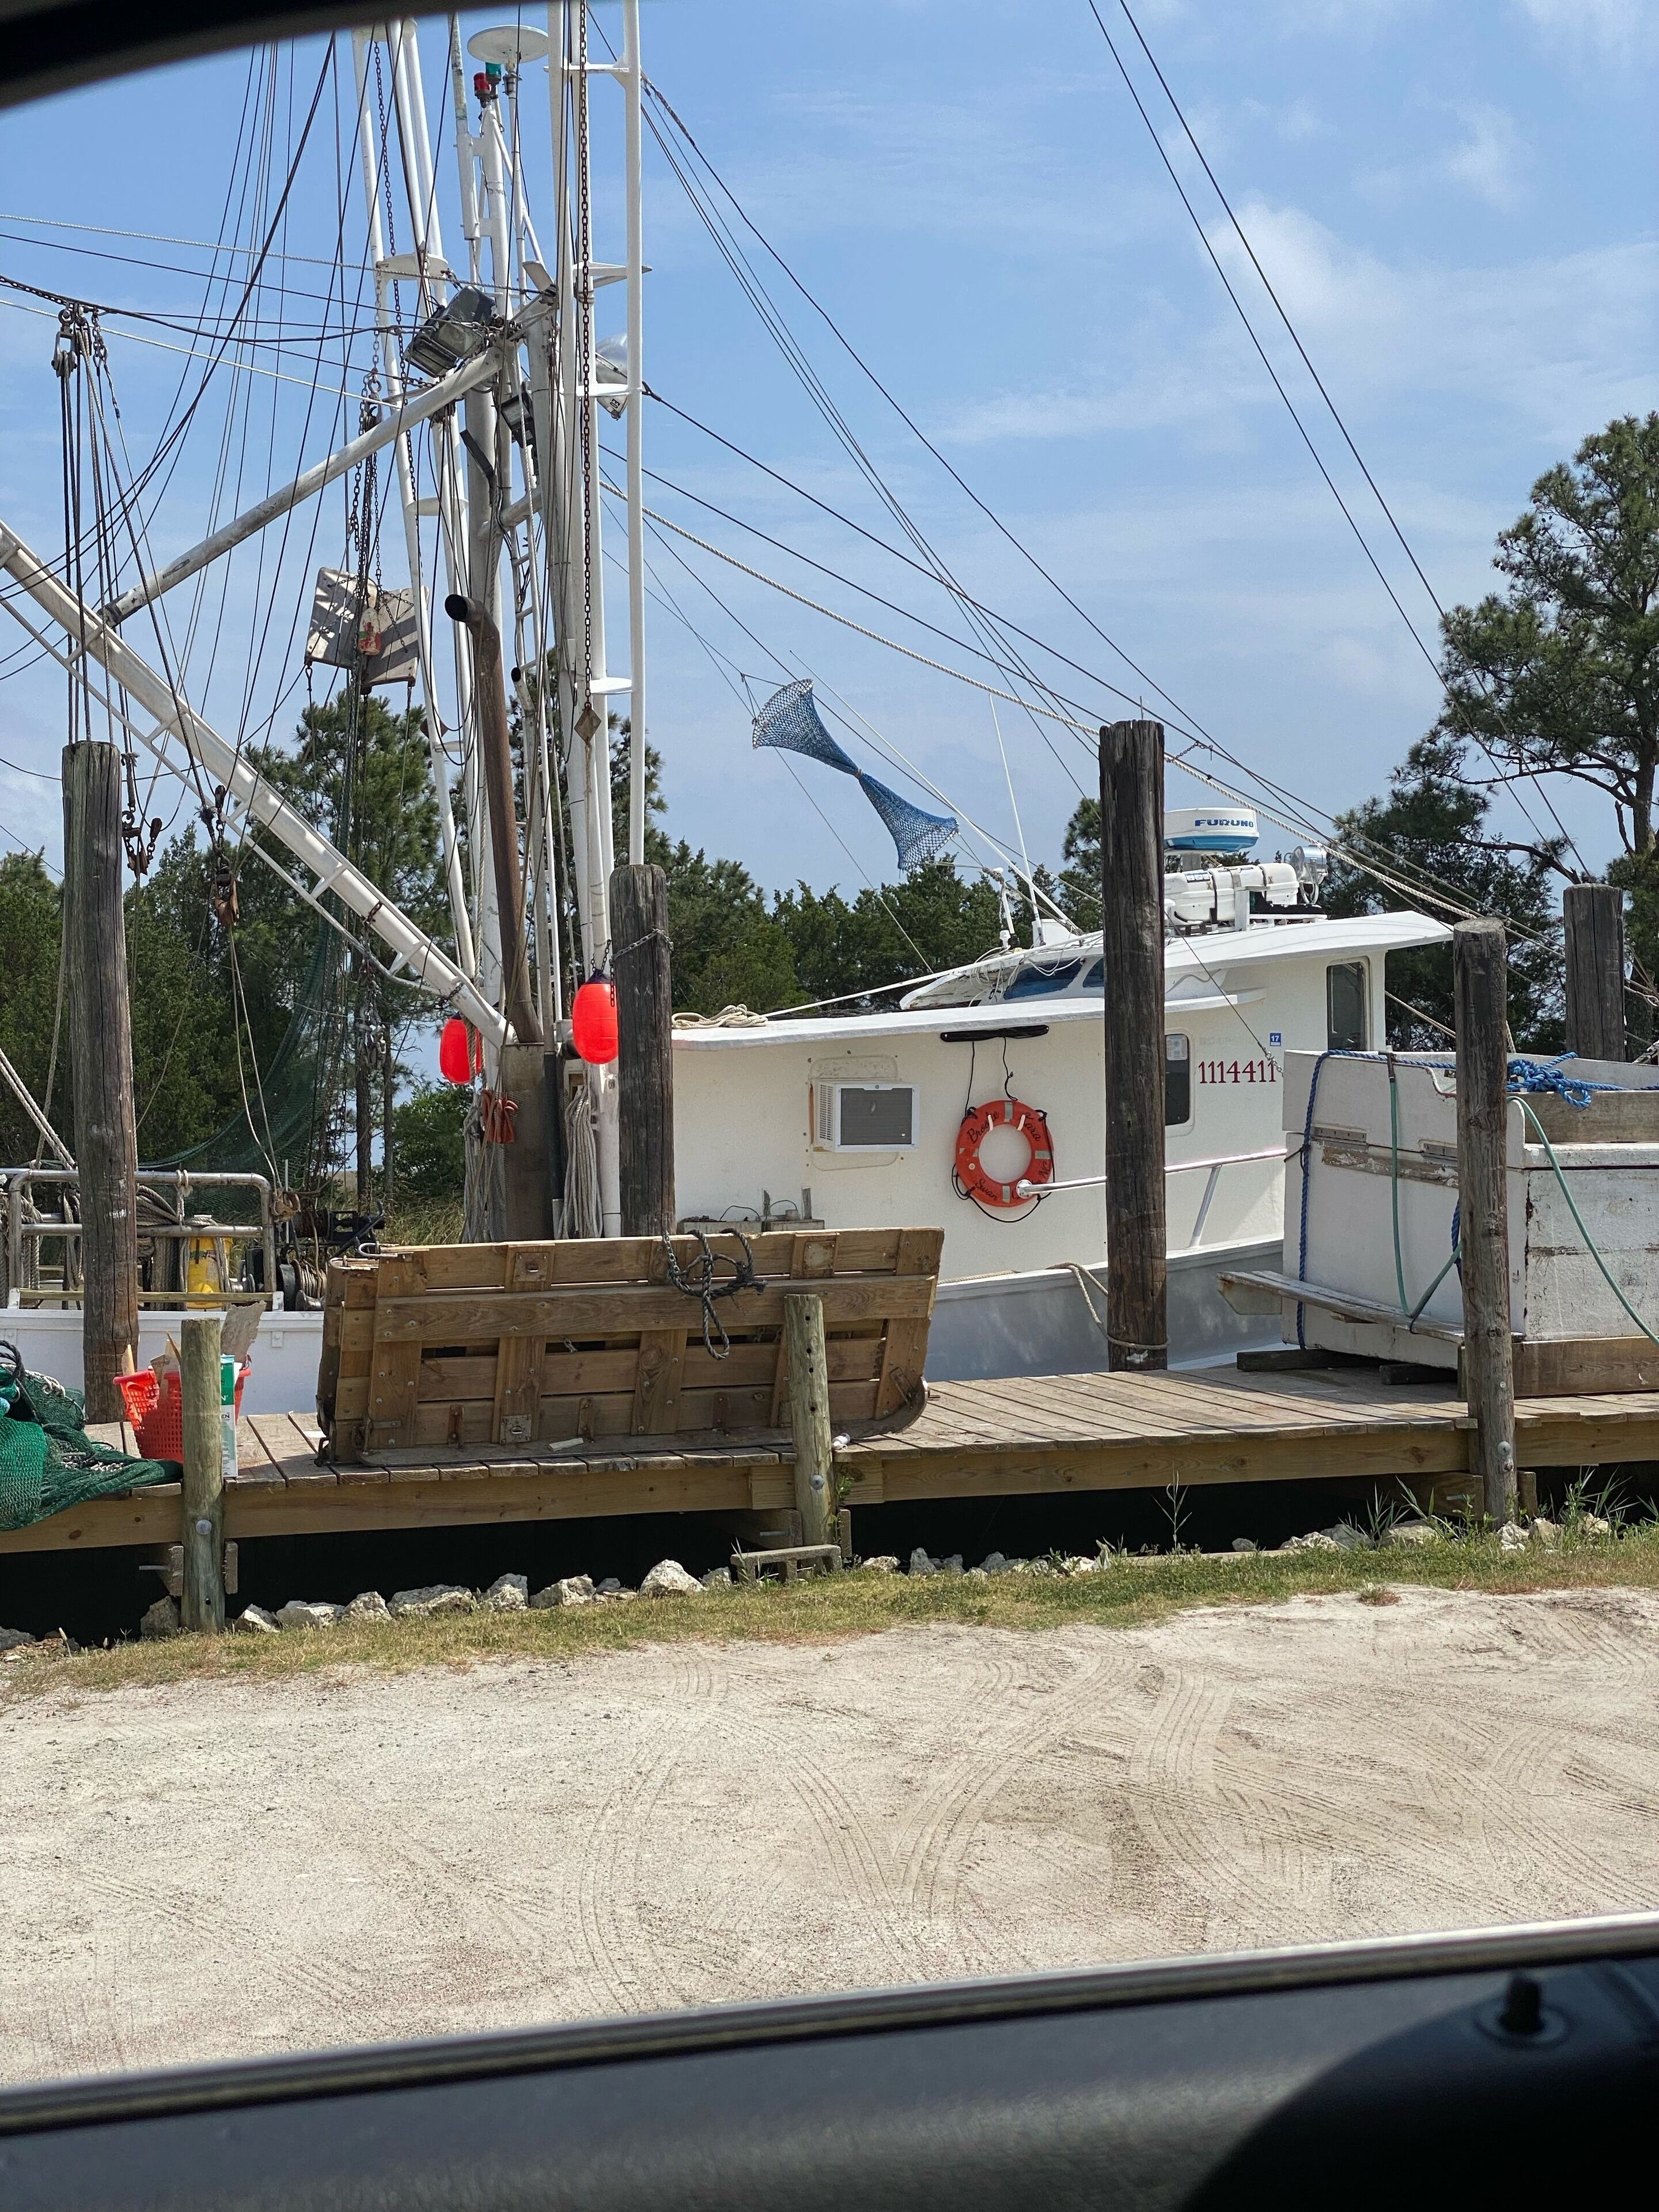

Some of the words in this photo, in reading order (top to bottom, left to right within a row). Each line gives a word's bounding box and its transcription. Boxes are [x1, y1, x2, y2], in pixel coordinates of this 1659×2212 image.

[1195, 819, 1253, 828] FURUNO
[1198, 1060, 1276, 1084] 1114411
[975, 1179, 998, 1200] Swan
[1038, 1161, 1050, 1179] NC
